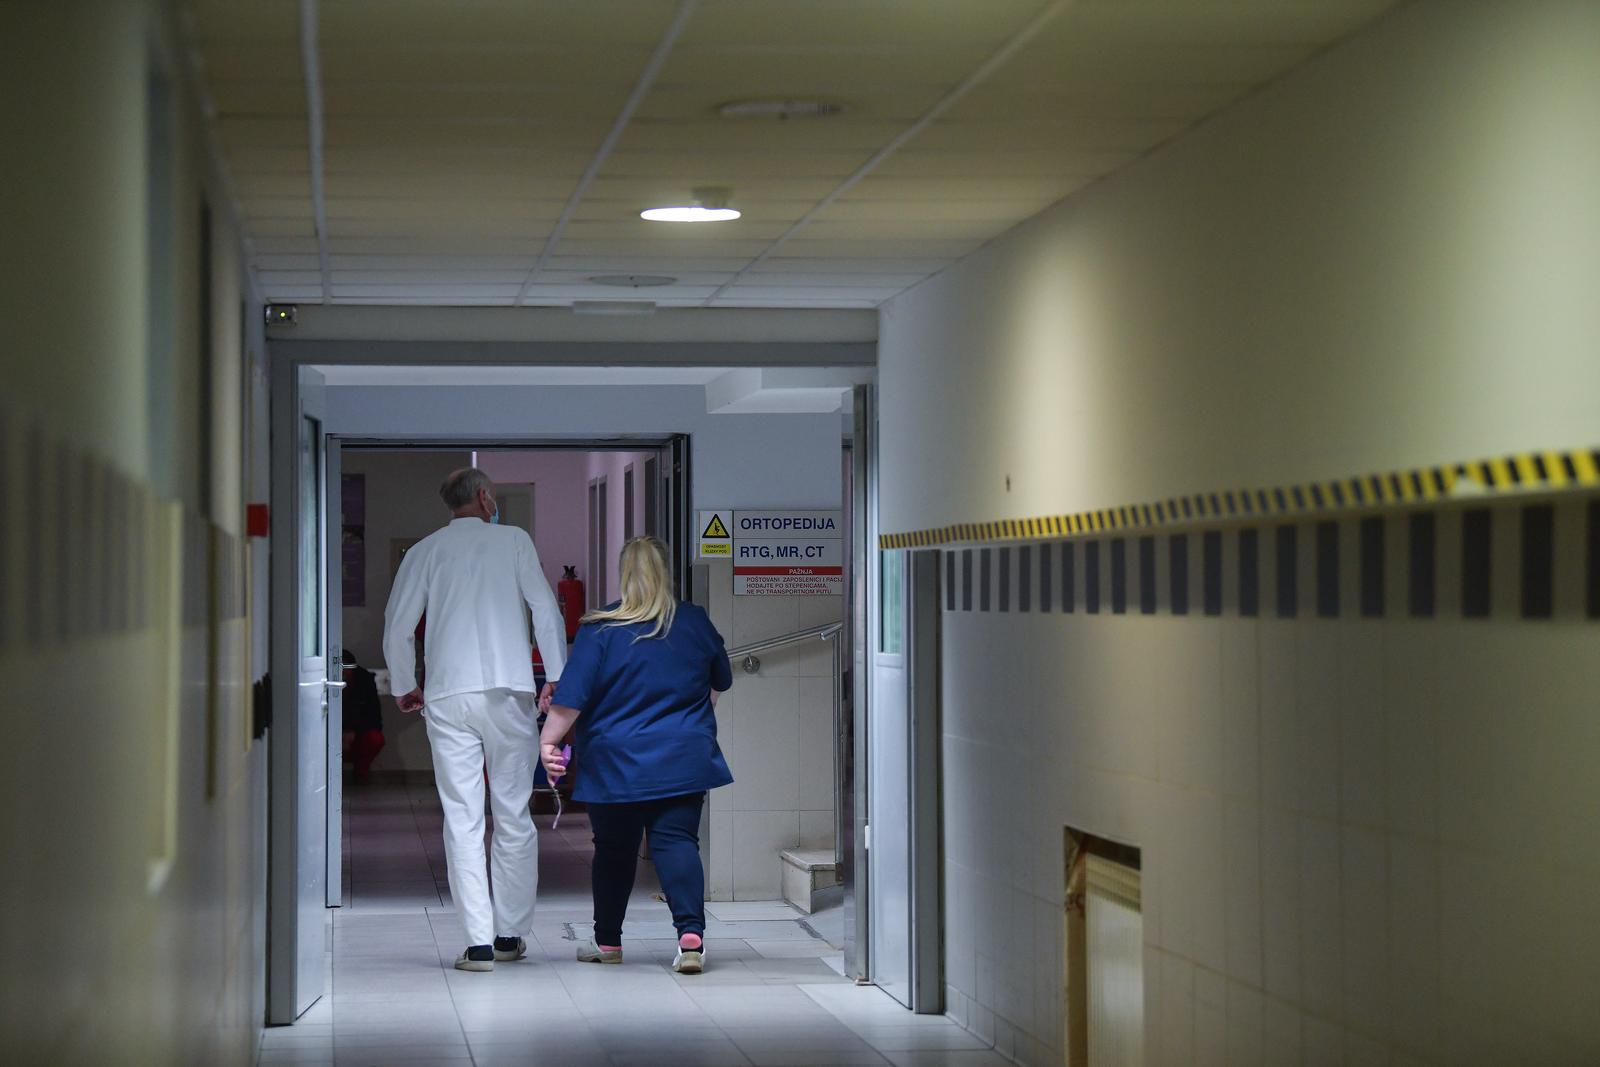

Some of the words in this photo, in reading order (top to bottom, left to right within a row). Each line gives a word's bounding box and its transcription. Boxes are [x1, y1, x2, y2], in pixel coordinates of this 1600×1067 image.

[740, 518, 835, 530] ORTOPEDIJA
[740, 546, 774, 560] RTG,
[776, 546, 803, 560] MR,
[805, 546, 825, 557] CT
